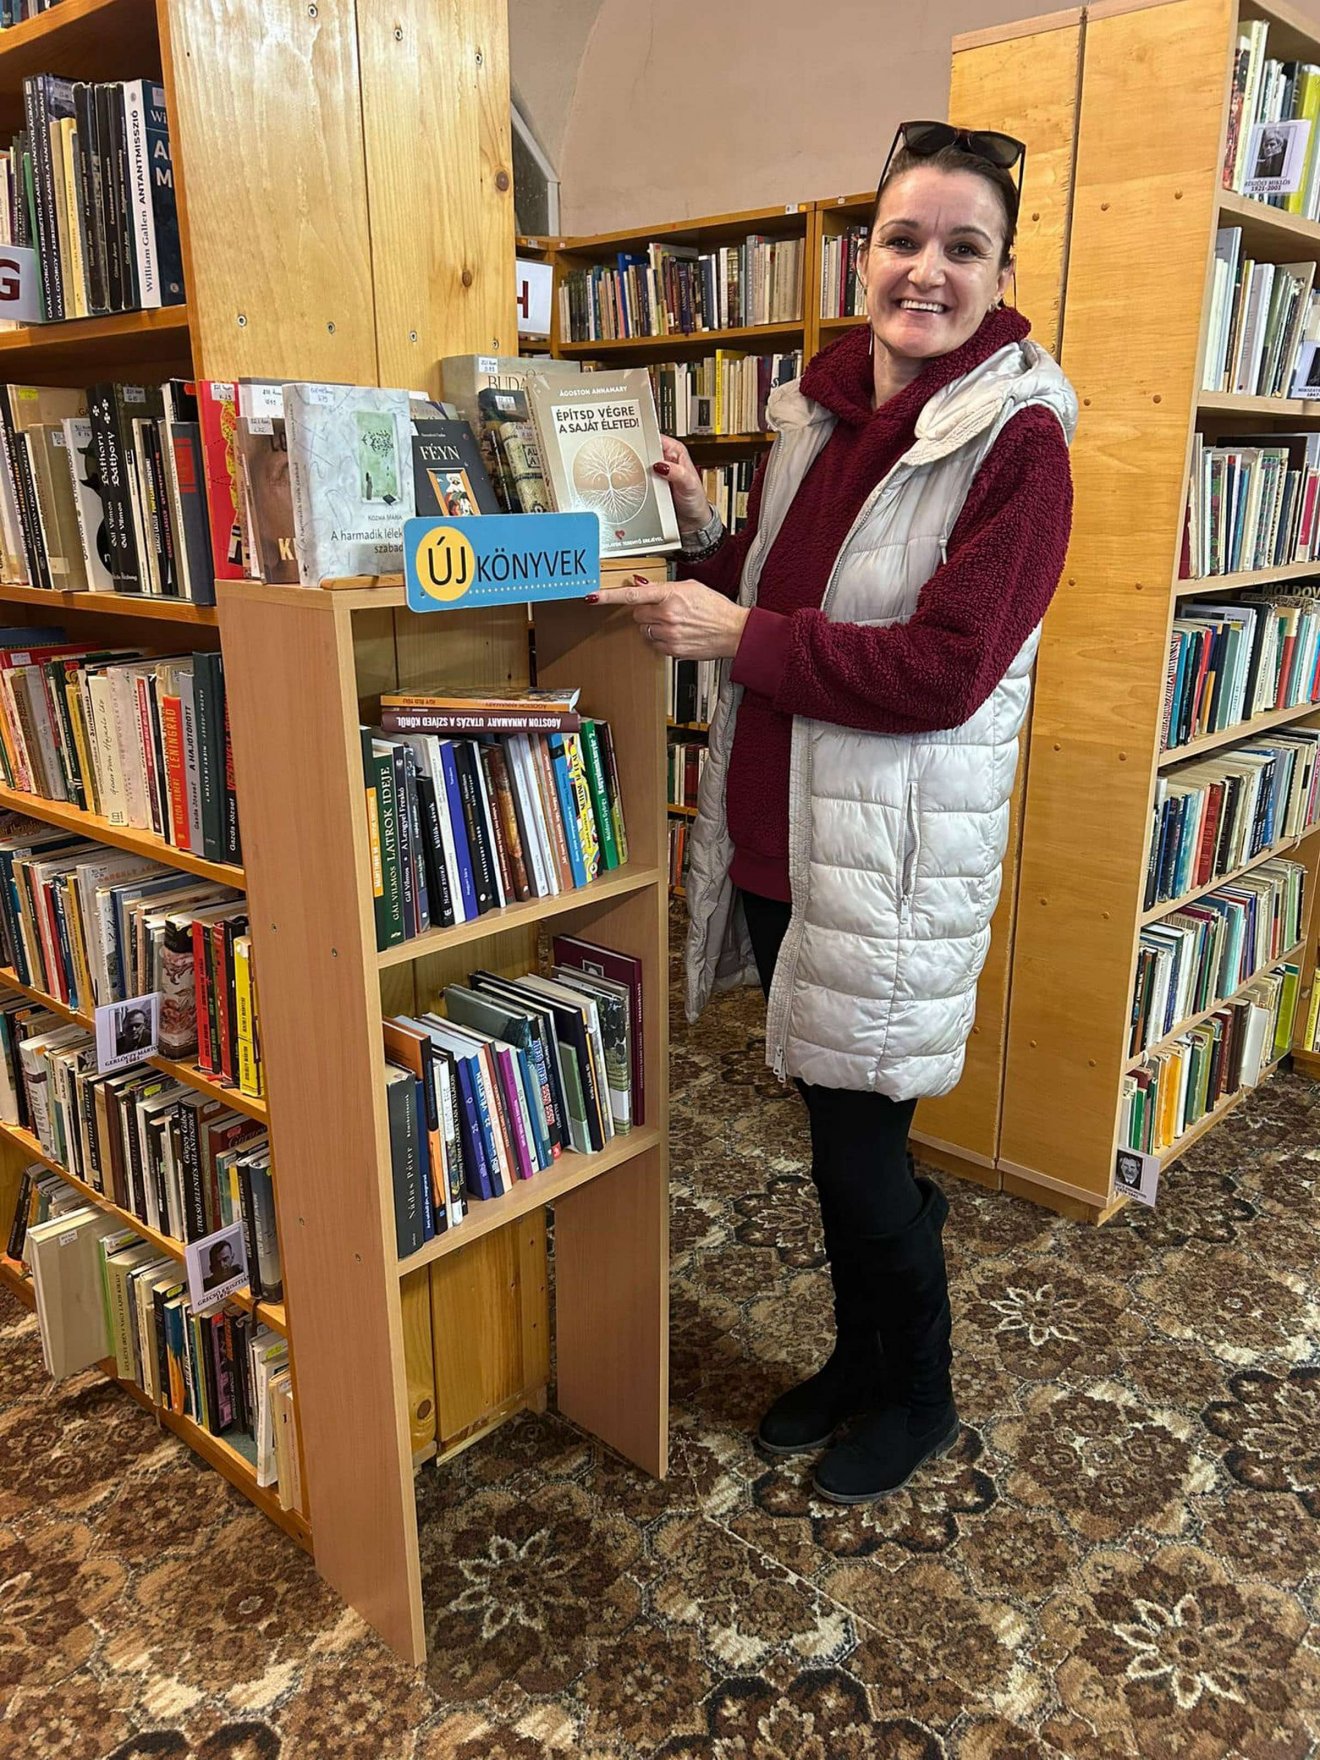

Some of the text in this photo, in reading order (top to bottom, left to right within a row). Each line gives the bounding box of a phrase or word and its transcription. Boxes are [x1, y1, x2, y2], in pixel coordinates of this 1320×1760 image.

[130, 110, 154, 292] William Gallen ANTANTMISSZIÓ
[560, 385, 628, 397] ÁGOSTON ANNAMARY
[556, 405, 635, 422] ÉPÍTSD VÉGRE
[560, 417, 640, 434] A SAJÁT ÉLETED!
[106, 432, 120, 486] Báthory
[420, 443, 461, 460] FÉYN
[331, 531, 339, 540] A
[340, 528, 382, 540] harmadik
[428, 536, 587, 586] ÚJ KÖNYVEK
[422, 716, 449, 728] SZÍVED
[450, 716, 456, 726] A
[456, 716, 484, 728] UTAZÁS
[488, 716, 528, 728] ANNAMARY
[528, 717, 562, 729] ÁGOSTON
[166, 708, 180, 769] LENINGRAD
[588, 730, 596, 738] 2.
[227, 797, 236, 825] József
[398, 787, 406, 812] Freskó
[601, 798, 610, 817] György
[228, 826, 236, 852] Gazda
[400, 814, 409, 844] Lengyel
[604, 818, 612, 841] Moldova
[380, 766, 400, 921] GÁL VILMOS LATROK IDEJE
[404, 888, 412, 903] Gál
[476, 1072, 488, 1111] VÉLETLEN
[180, 1106, 192, 1164] Görgey Gábor
[472, 1120, 480, 1134] 25.
[188, 1112, 204, 1234] UTOLSÓ JELENTÉS ATLANTISZRÓL
[404, 1146, 414, 1178] Péter
[406, 1182, 416, 1219] Nádas
